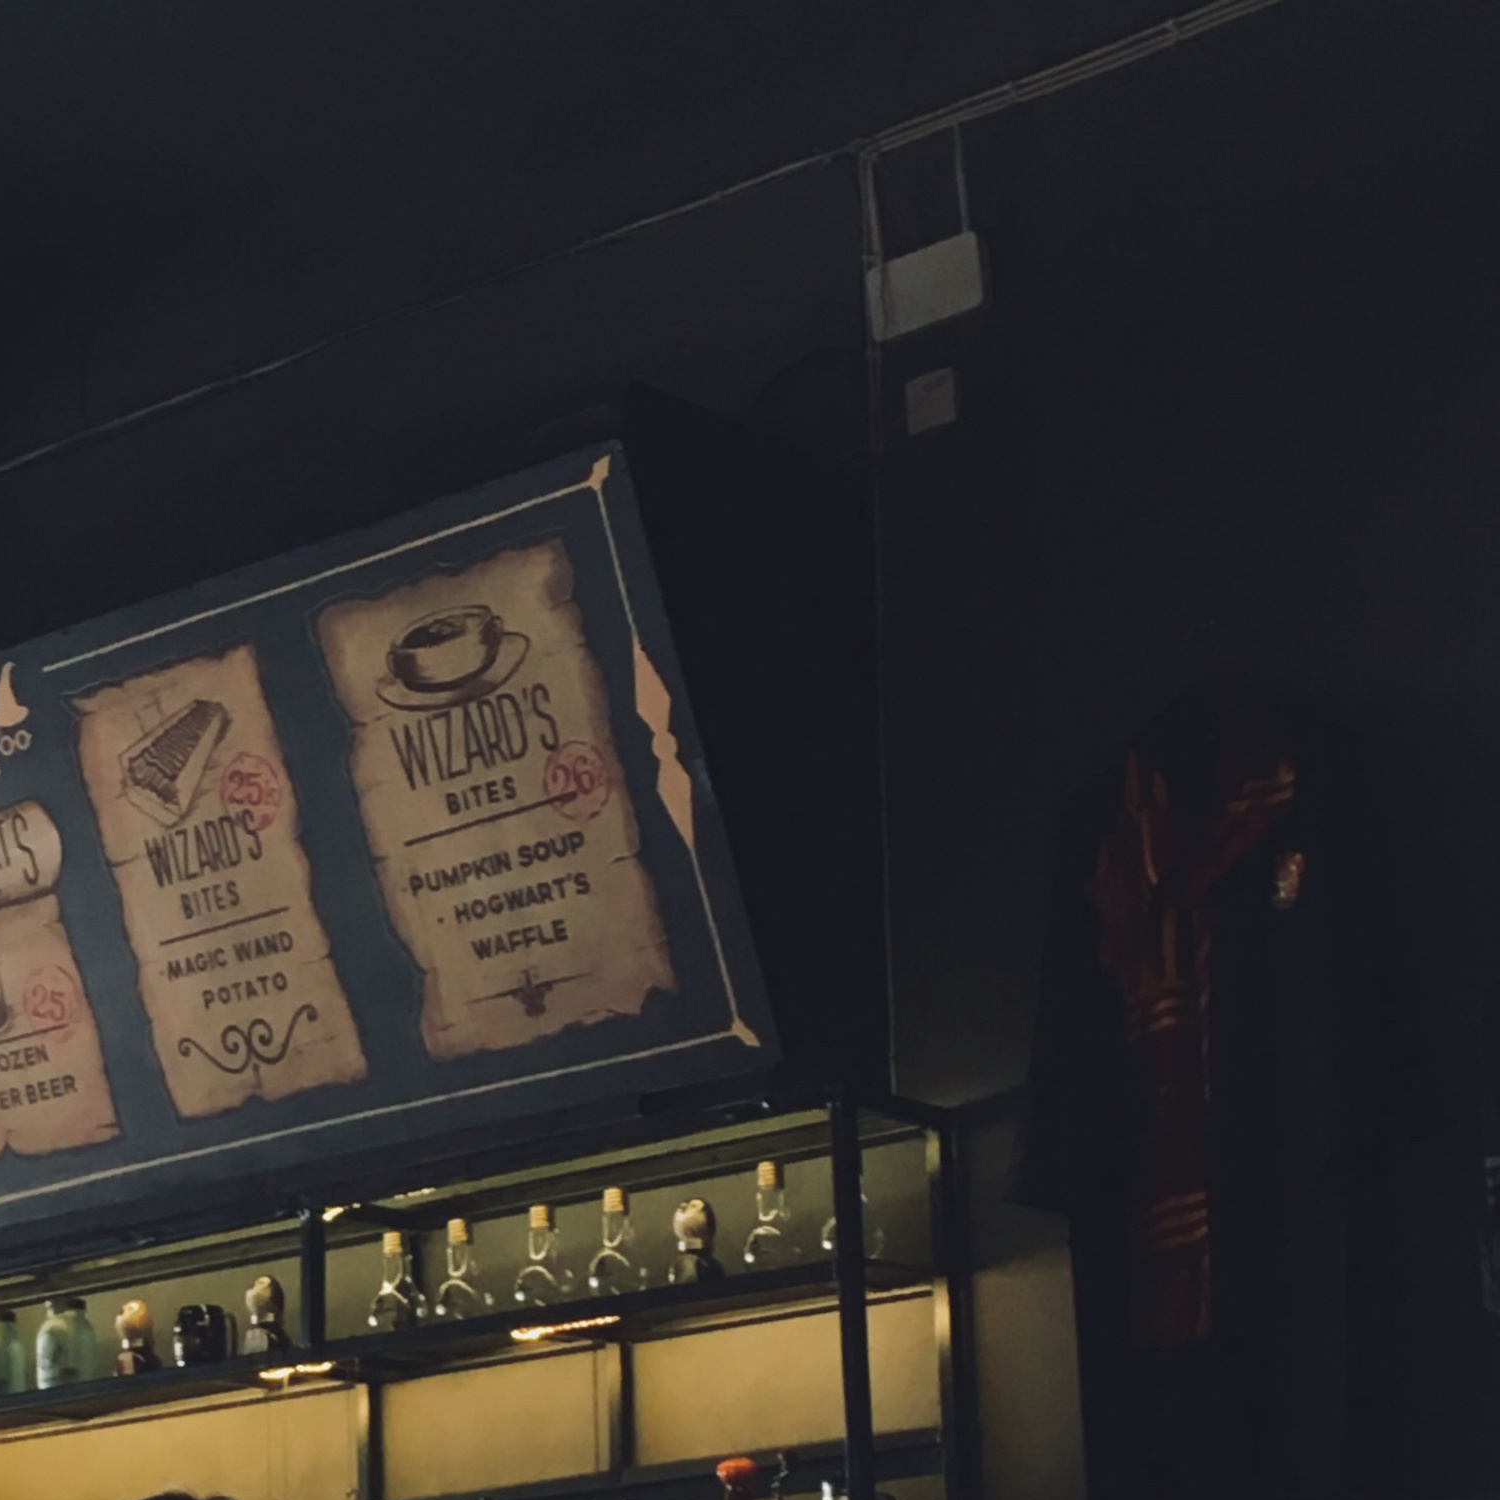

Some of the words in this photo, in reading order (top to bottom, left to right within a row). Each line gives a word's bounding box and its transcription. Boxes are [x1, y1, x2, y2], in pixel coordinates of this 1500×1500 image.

[390, 682, 560, 791] WIZARD'S
[446, 776, 518, 816] BITES
[144, 808, 263, 888] WIZARD'S
[409, 851, 512, 897] PUMPKIN
[518, 831, 586, 868] SOUP
[180, 881, 241, 920] BITES
[454, 873, 591, 924] HOGWART'S
[166, 947, 227, 980] MAGIC
[233, 930, 294, 963] WAND
[471, 919, 568, 961] WAFFLE
[203, 971, 288, 1010] POTATO
[27, 1074, 77, 1105] BEER
